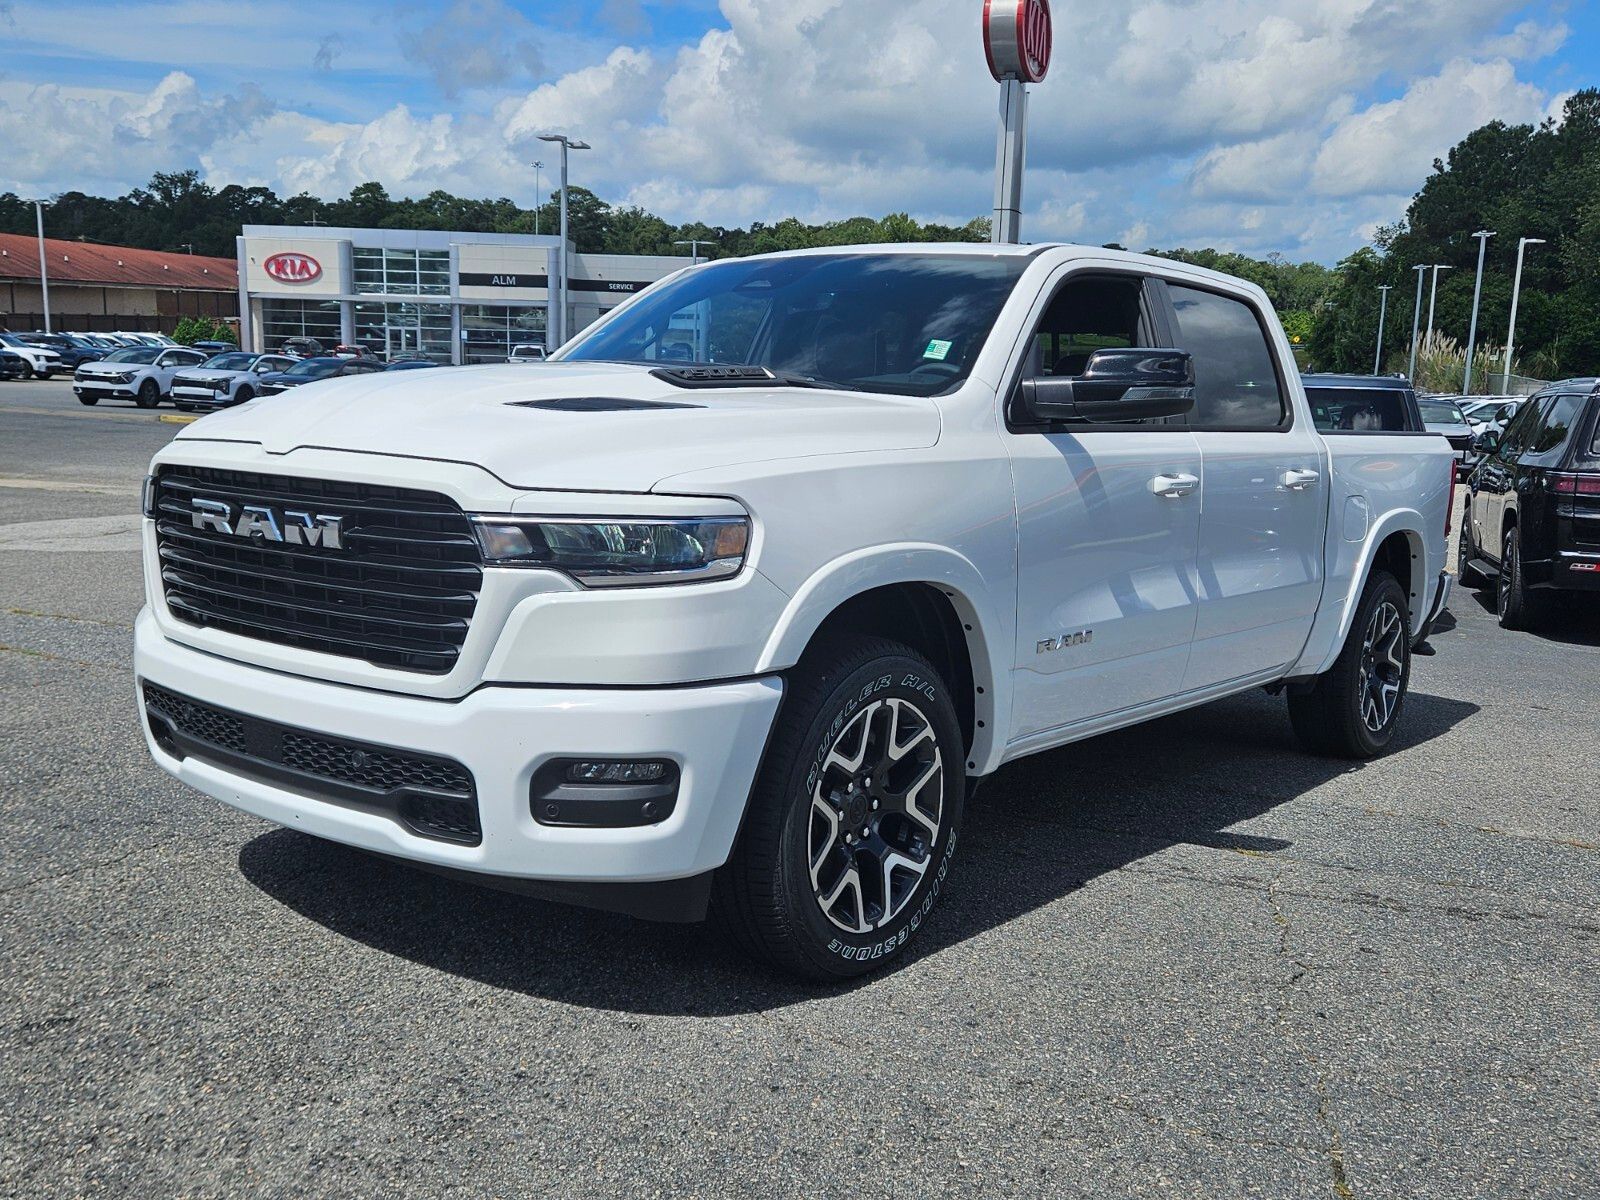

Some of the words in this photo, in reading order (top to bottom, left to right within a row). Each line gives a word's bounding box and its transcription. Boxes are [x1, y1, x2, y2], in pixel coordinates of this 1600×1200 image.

[272, 258, 313, 277] KIA
[491, 275, 516, 286] ALM
[608, 283, 634, 291] SERVICE
[191, 497, 344, 550] RAM
[1036, 629, 1093, 654] RAM
[806, 674, 892, 795] DUELER
[900, 673, 936, 701] H/L
[827, 826, 957, 961] BRIDGESTONE
